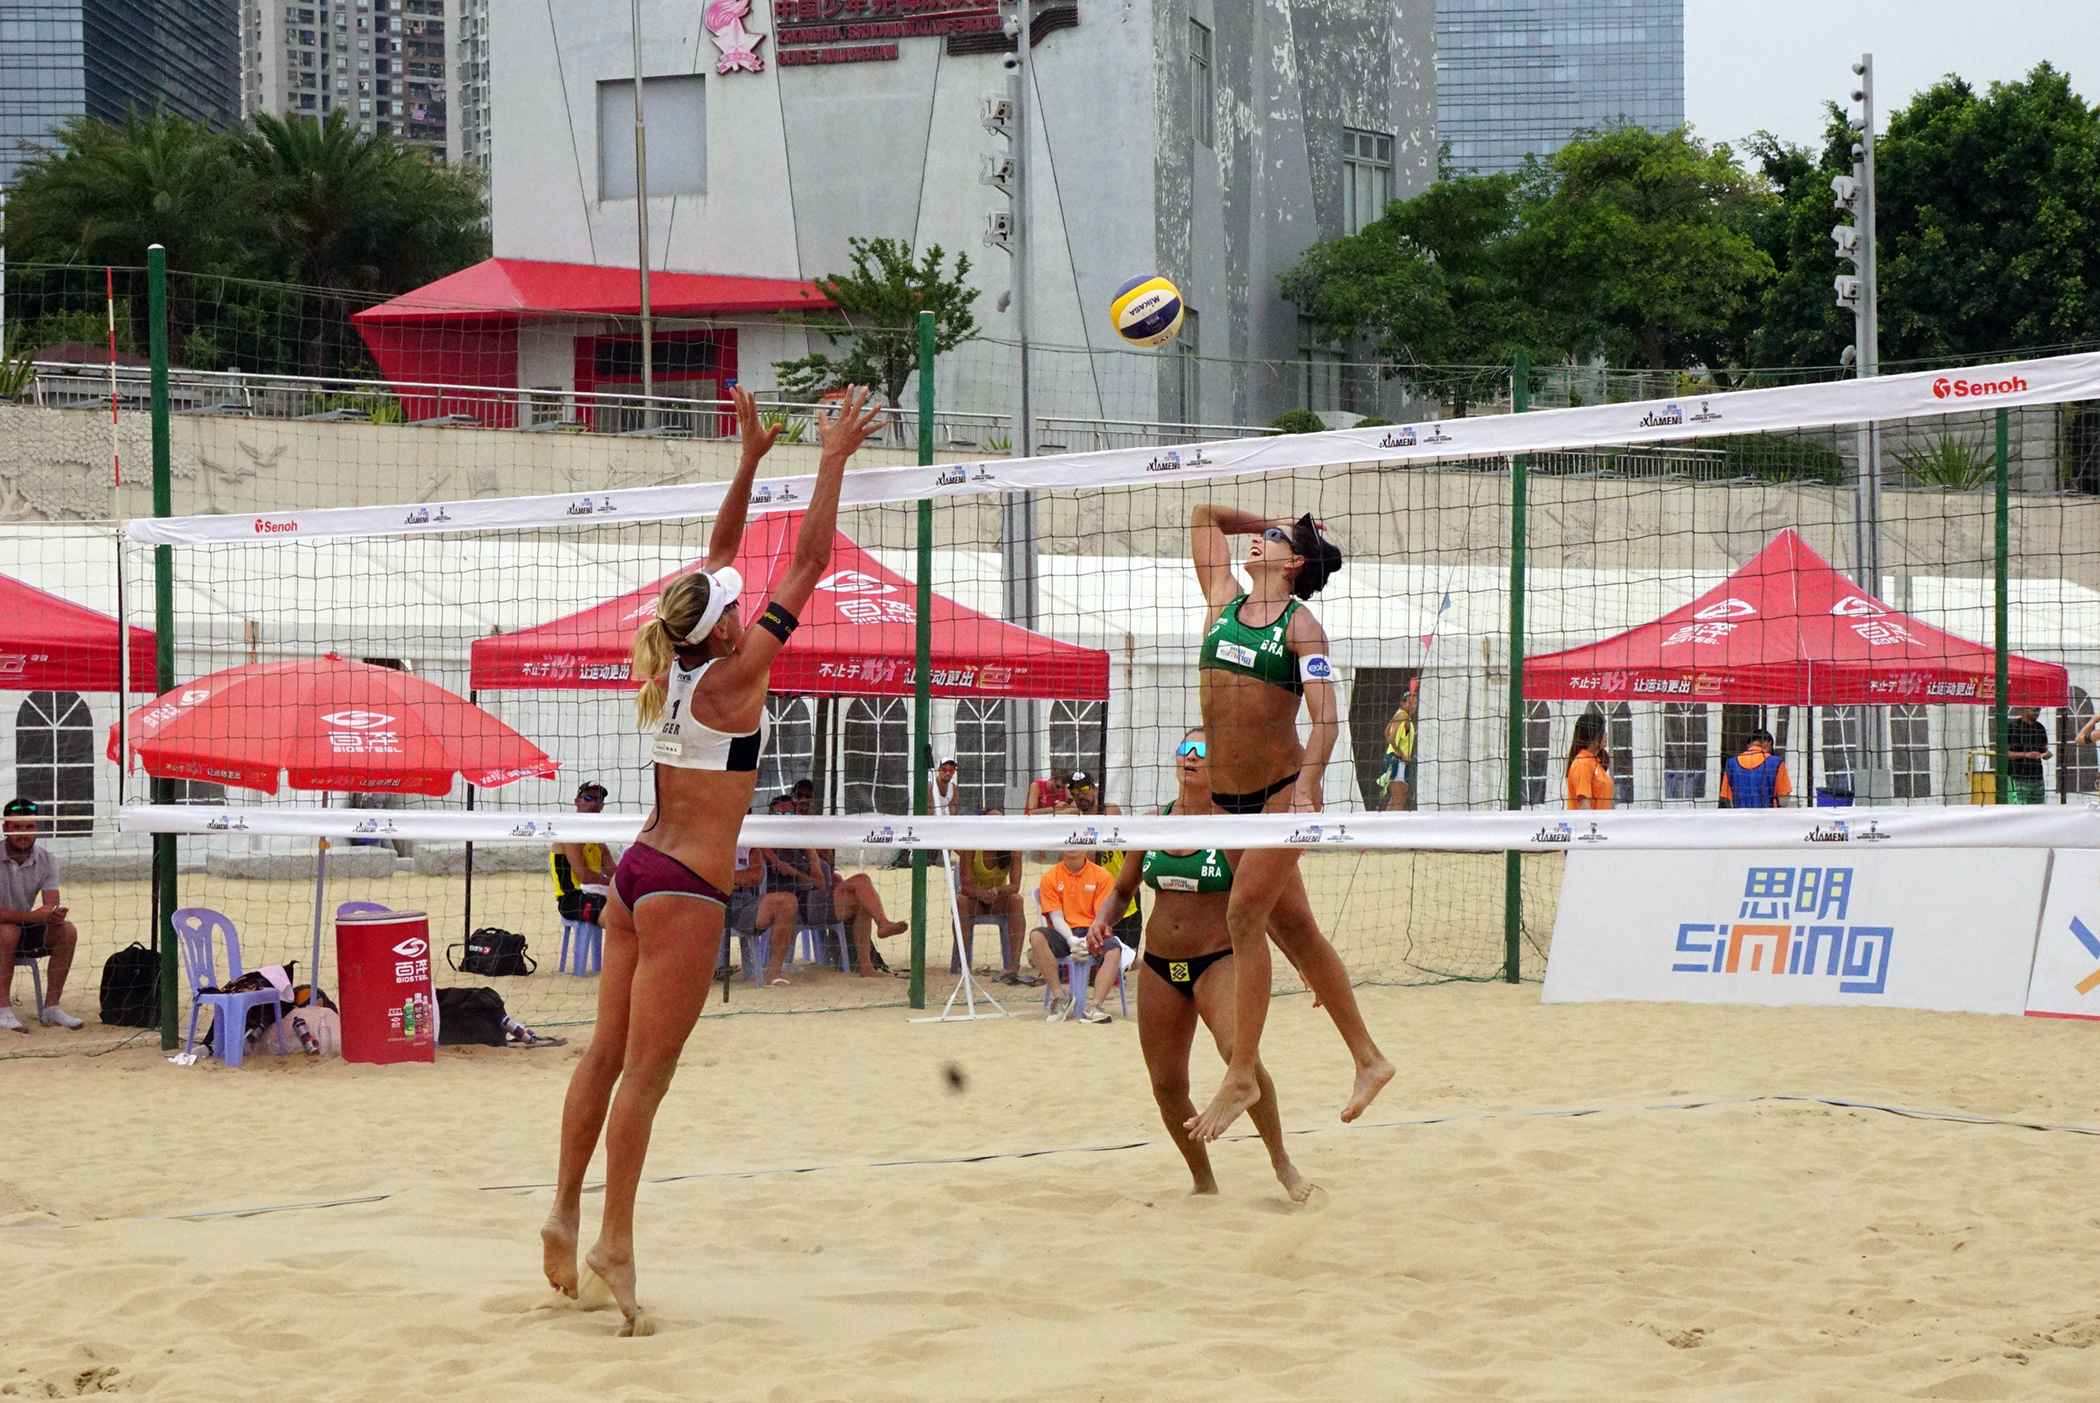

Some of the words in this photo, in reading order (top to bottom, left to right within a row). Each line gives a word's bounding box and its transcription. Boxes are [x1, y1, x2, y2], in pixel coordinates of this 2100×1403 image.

[1129, 295, 1160, 316] MIKASA
[1953, 376, 2027, 397] Senoh
[264, 520, 298, 533] Senoh
[1273, 626, 1283, 642] 1
[1260, 639, 1284, 657] BRA
[671, 700, 681, 719] 1
[662, 723, 680, 735] GER
[1206, 849, 1216, 864] 2
[1201, 866, 1222, 877] BRA
[1739, 868, 1853, 920] 思明
[1672, 924, 1894, 994] siming
[396, 975, 429, 983] BIOSTEEL
